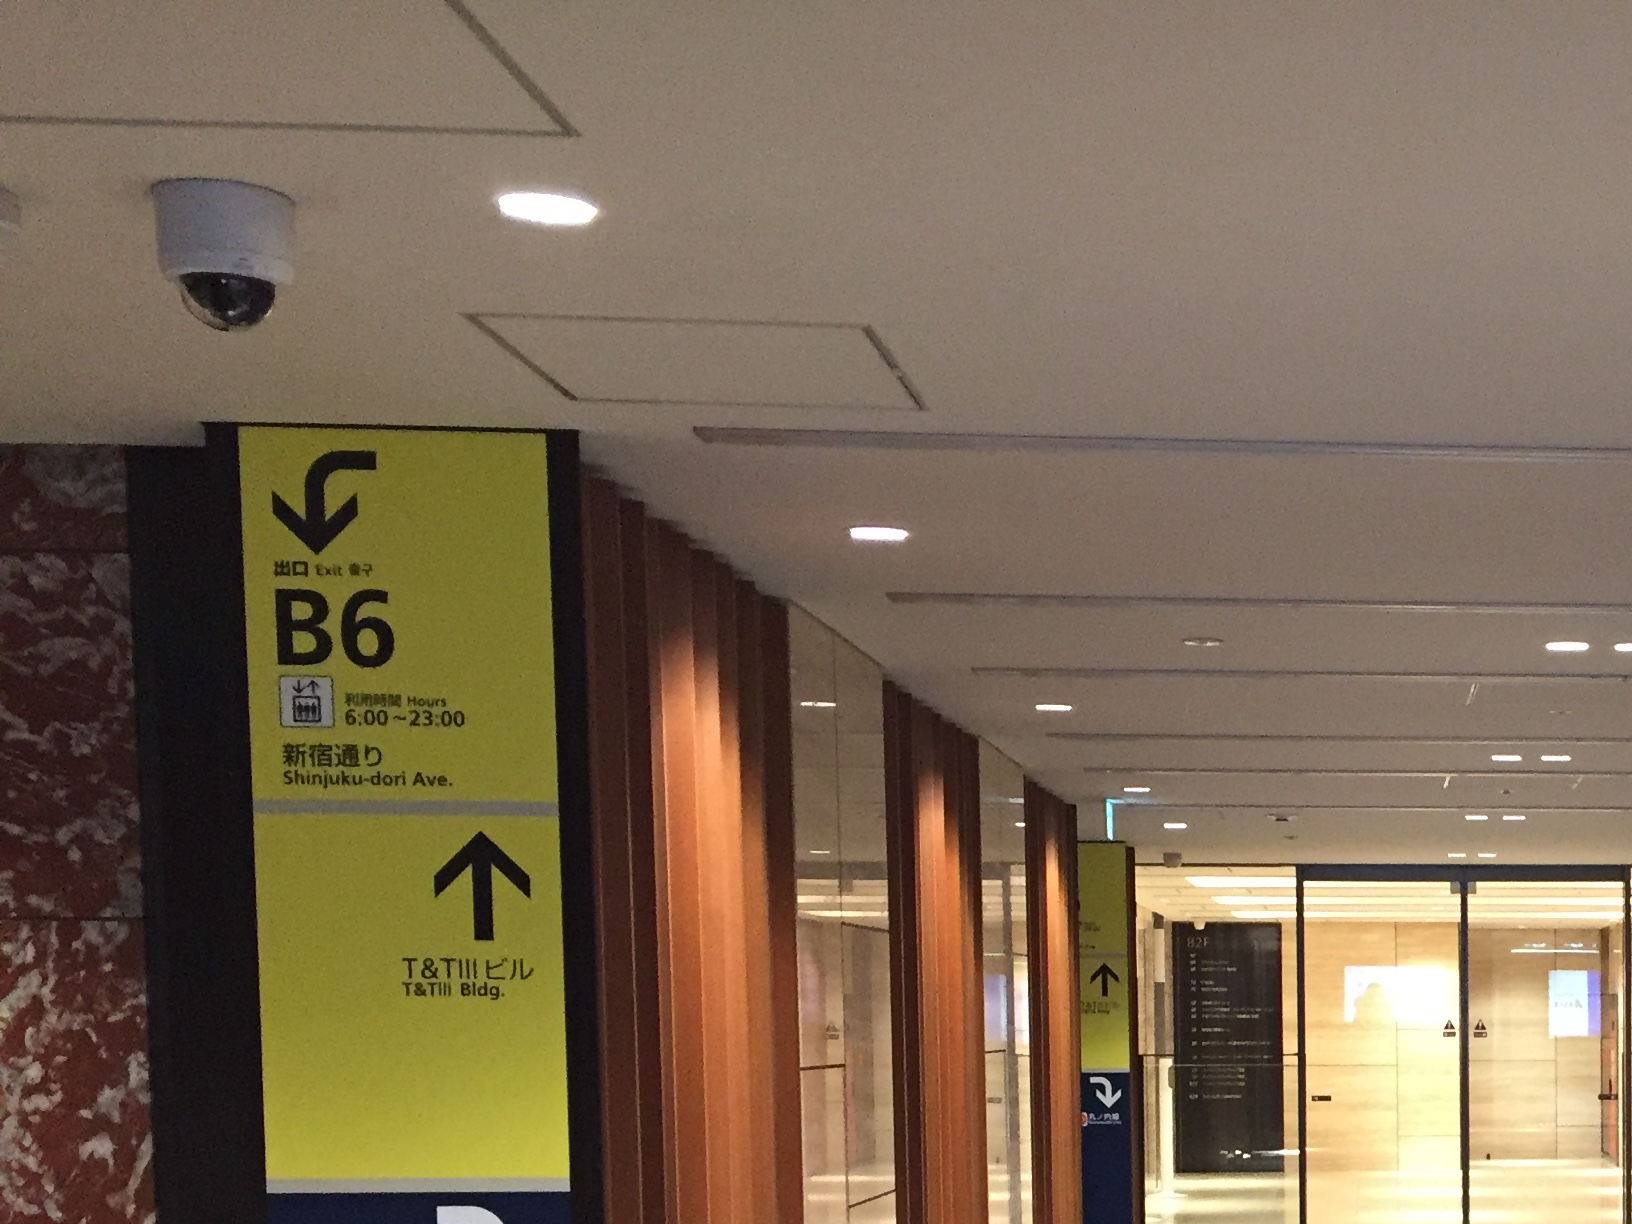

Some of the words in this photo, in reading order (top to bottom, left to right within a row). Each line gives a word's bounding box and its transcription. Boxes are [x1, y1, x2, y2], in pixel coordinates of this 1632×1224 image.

[274, 560, 308, 577] 出口
[315, 563, 342, 577] Exit
[274, 588, 395, 669] B6
[407, 696, 447, 708] Hours
[282, 742, 383, 767] 新宿通り
[283, 770, 406, 789] Shinjuku-dori
[412, 771, 453, 787] Ave.
[460, 981, 505, 1000] Bldg.
